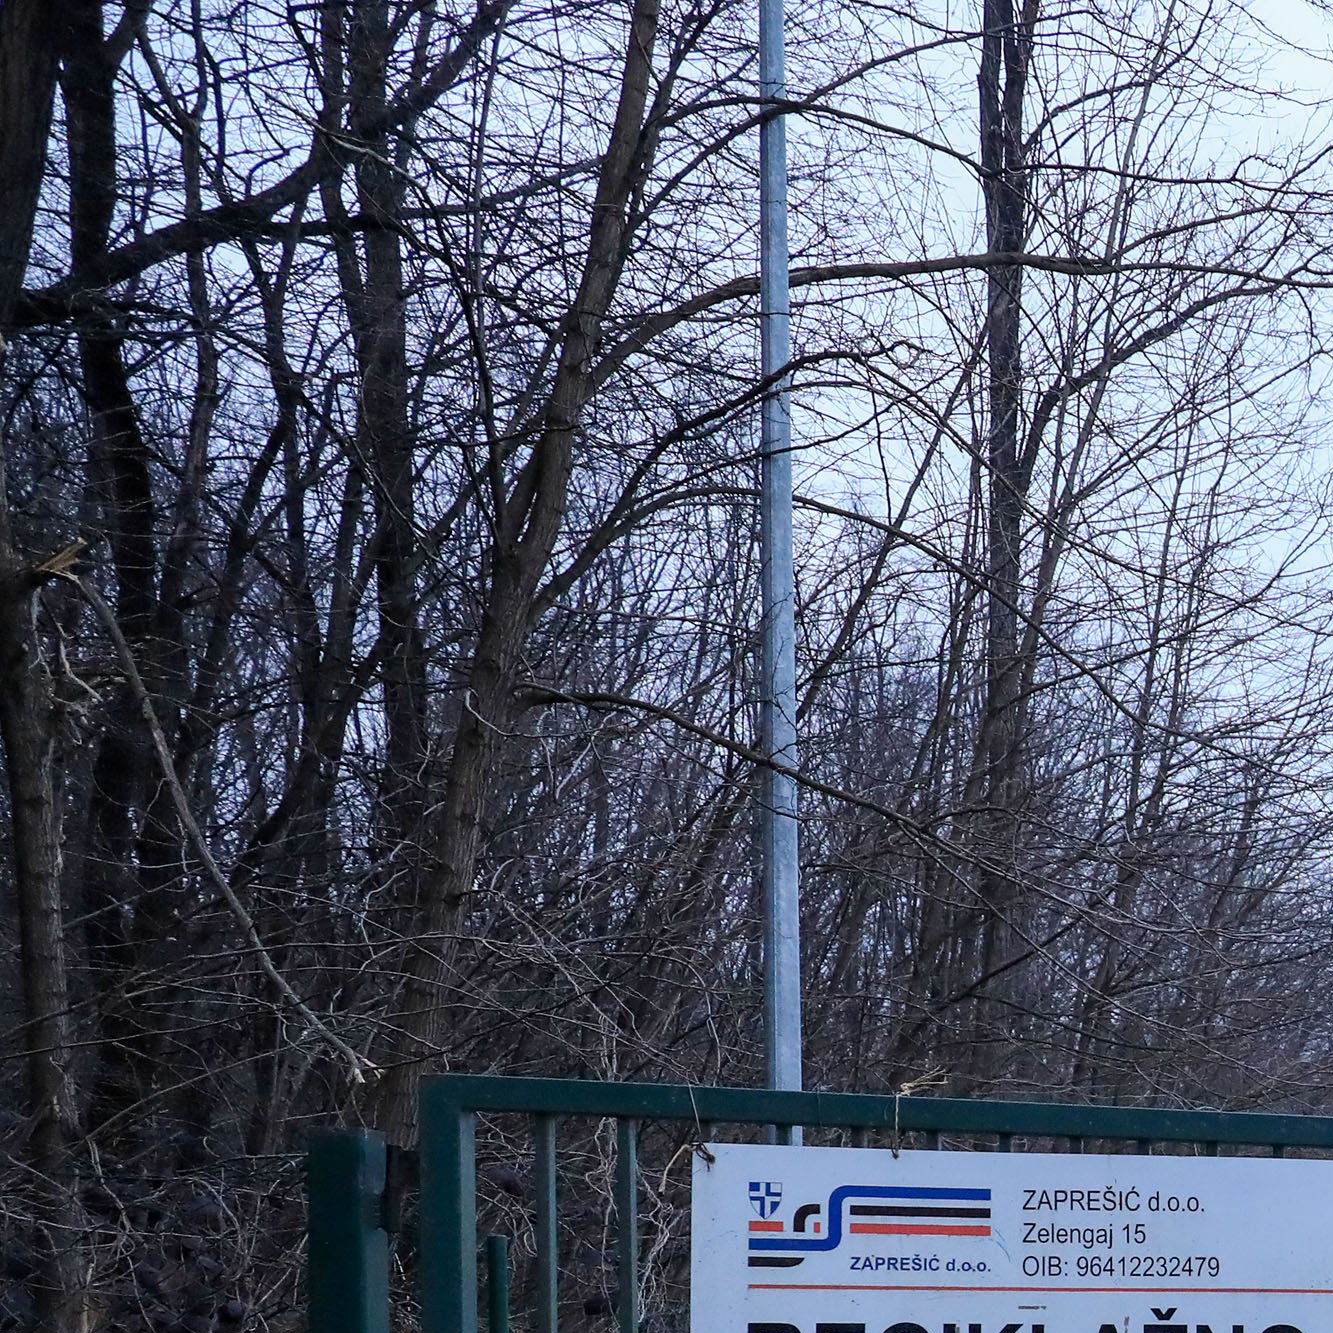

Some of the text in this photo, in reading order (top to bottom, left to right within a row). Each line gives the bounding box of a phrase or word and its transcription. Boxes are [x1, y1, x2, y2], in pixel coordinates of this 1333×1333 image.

[1023, 1186, 1204, 1212] ZAPREŠIĆ d.o.o.
[1023, 1223, 1145, 1249] Zelengaj 15
[850, 1254, 990, 1272] ZAPREŠIĆ d.o.o.
[1023, 1256, 1219, 1277] OIB: 96412232479
